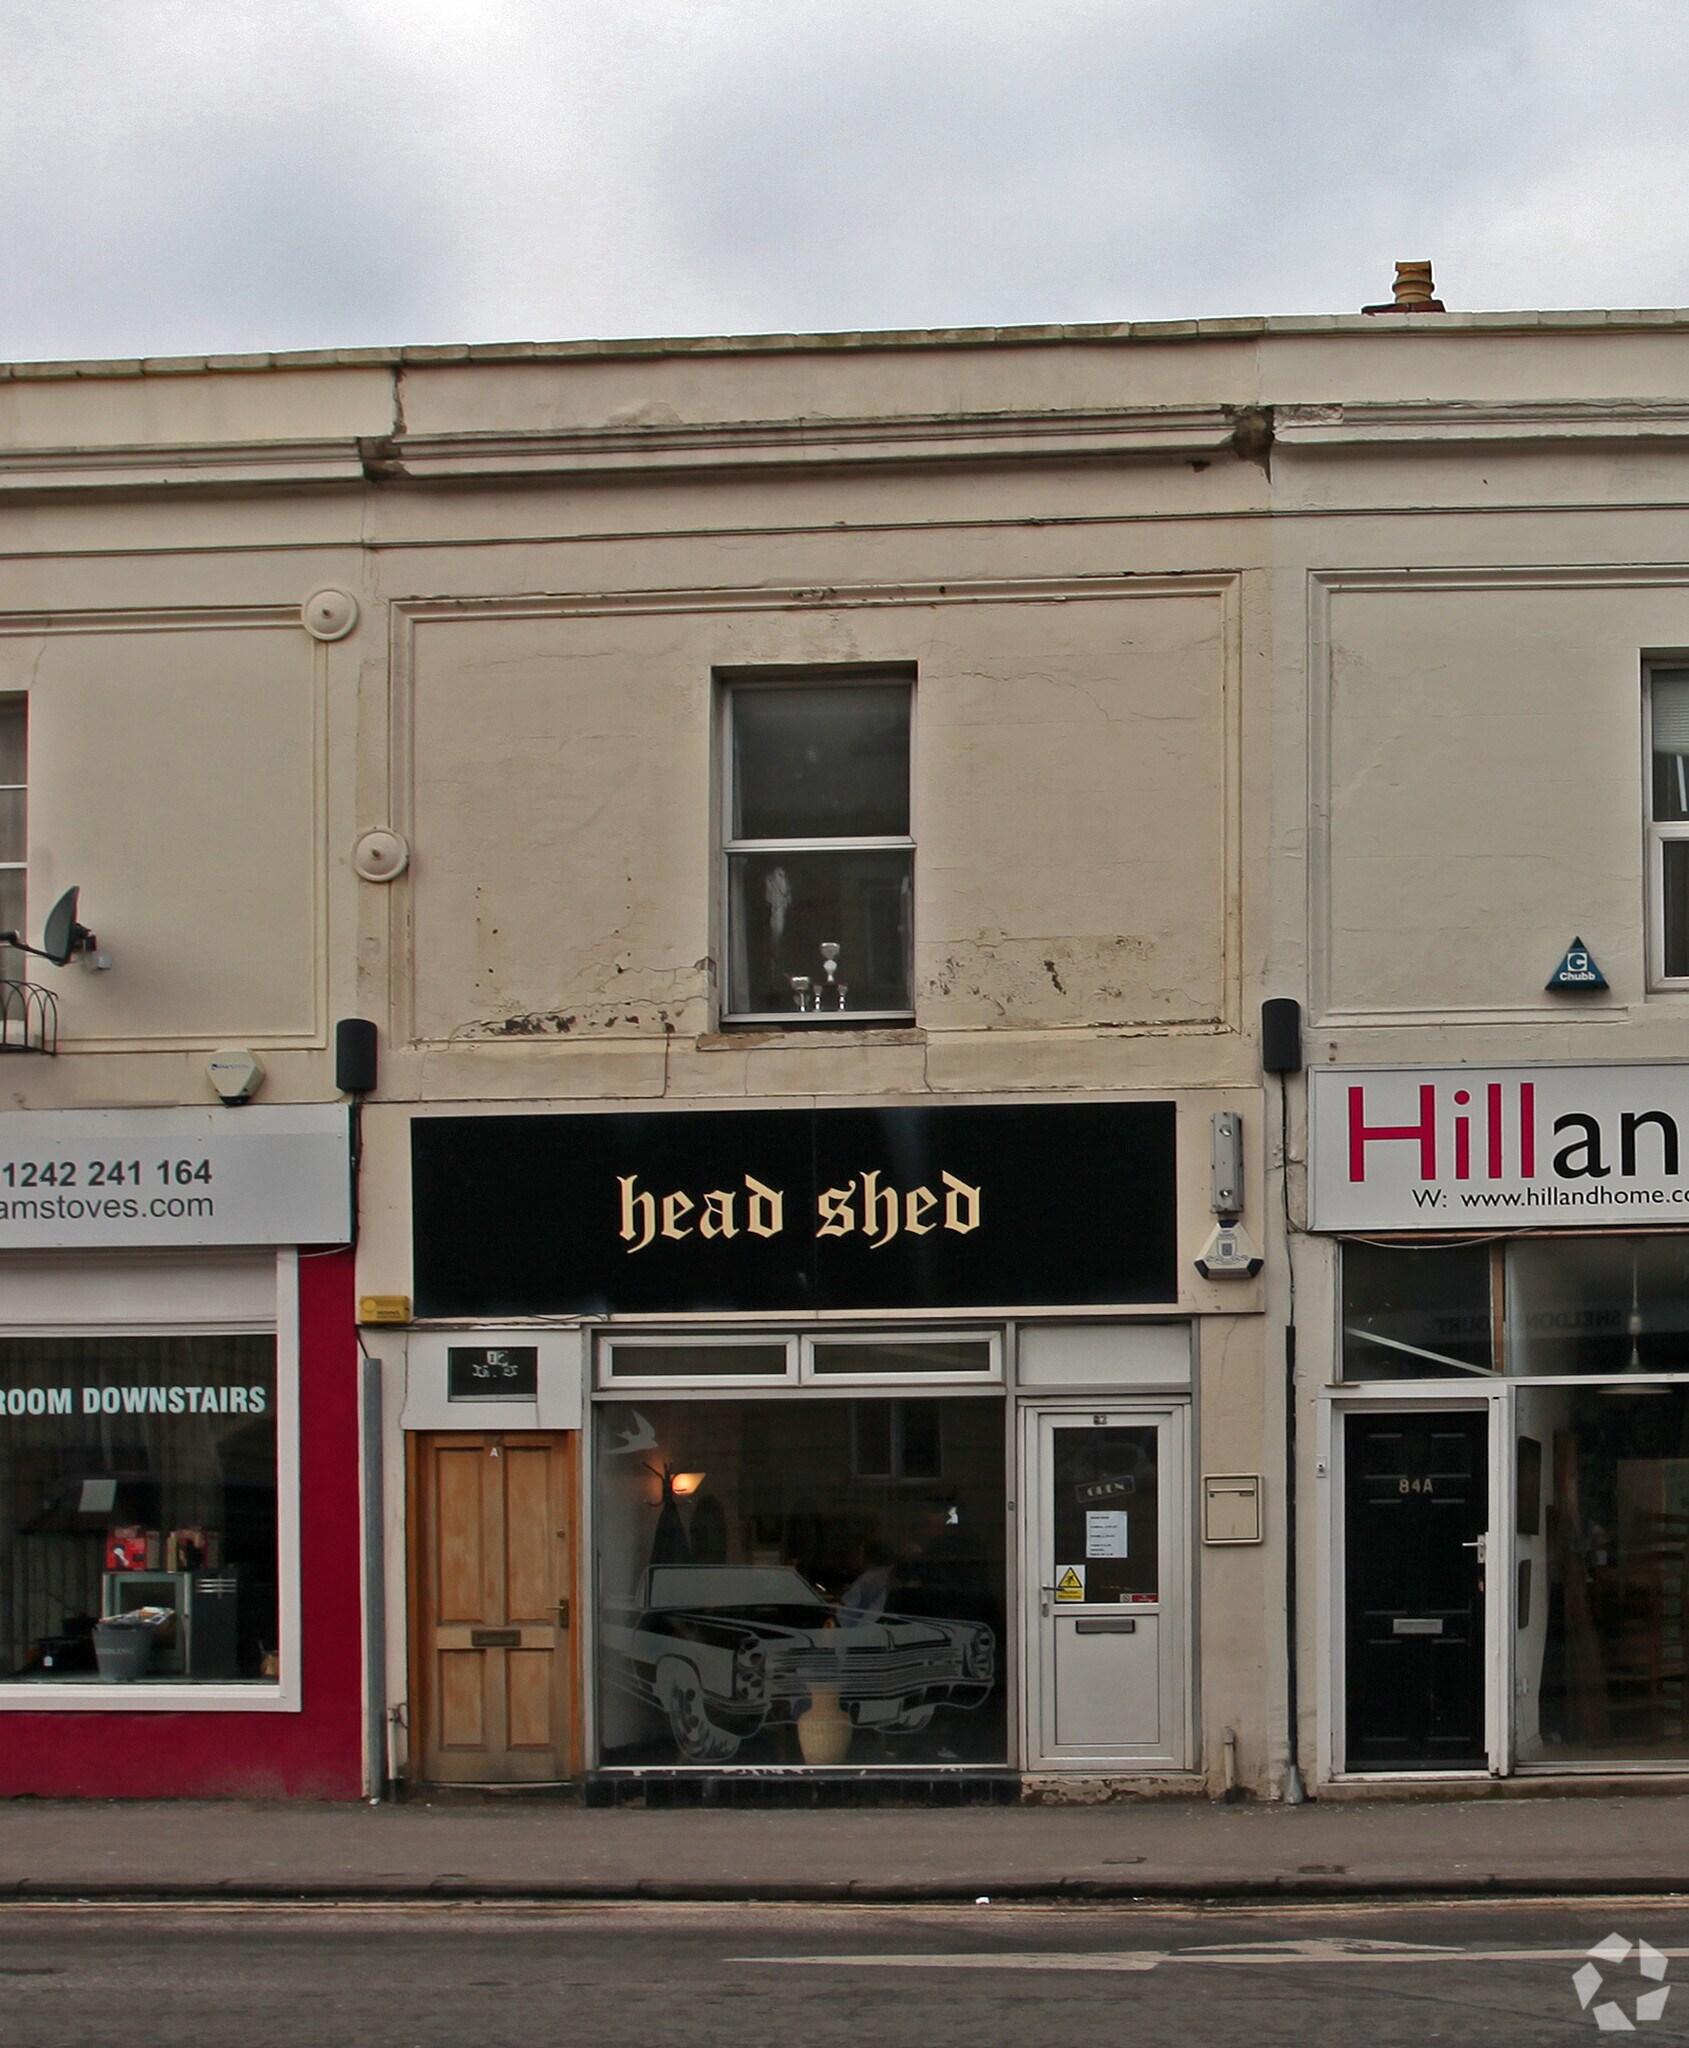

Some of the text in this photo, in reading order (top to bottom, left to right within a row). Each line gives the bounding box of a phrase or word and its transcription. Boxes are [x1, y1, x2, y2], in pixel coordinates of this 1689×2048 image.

[1559, 972, 1596, 981] Chubb
[3, 1159, 212, 1187] 1242 241 164
[1412, 1189, 1447, 1208] W:
[616, 1169, 981, 1254] head shed
[83, 1386, 266, 1414] DOWNSTAIRS
[1399, 1478, 1433, 1493] 84A
